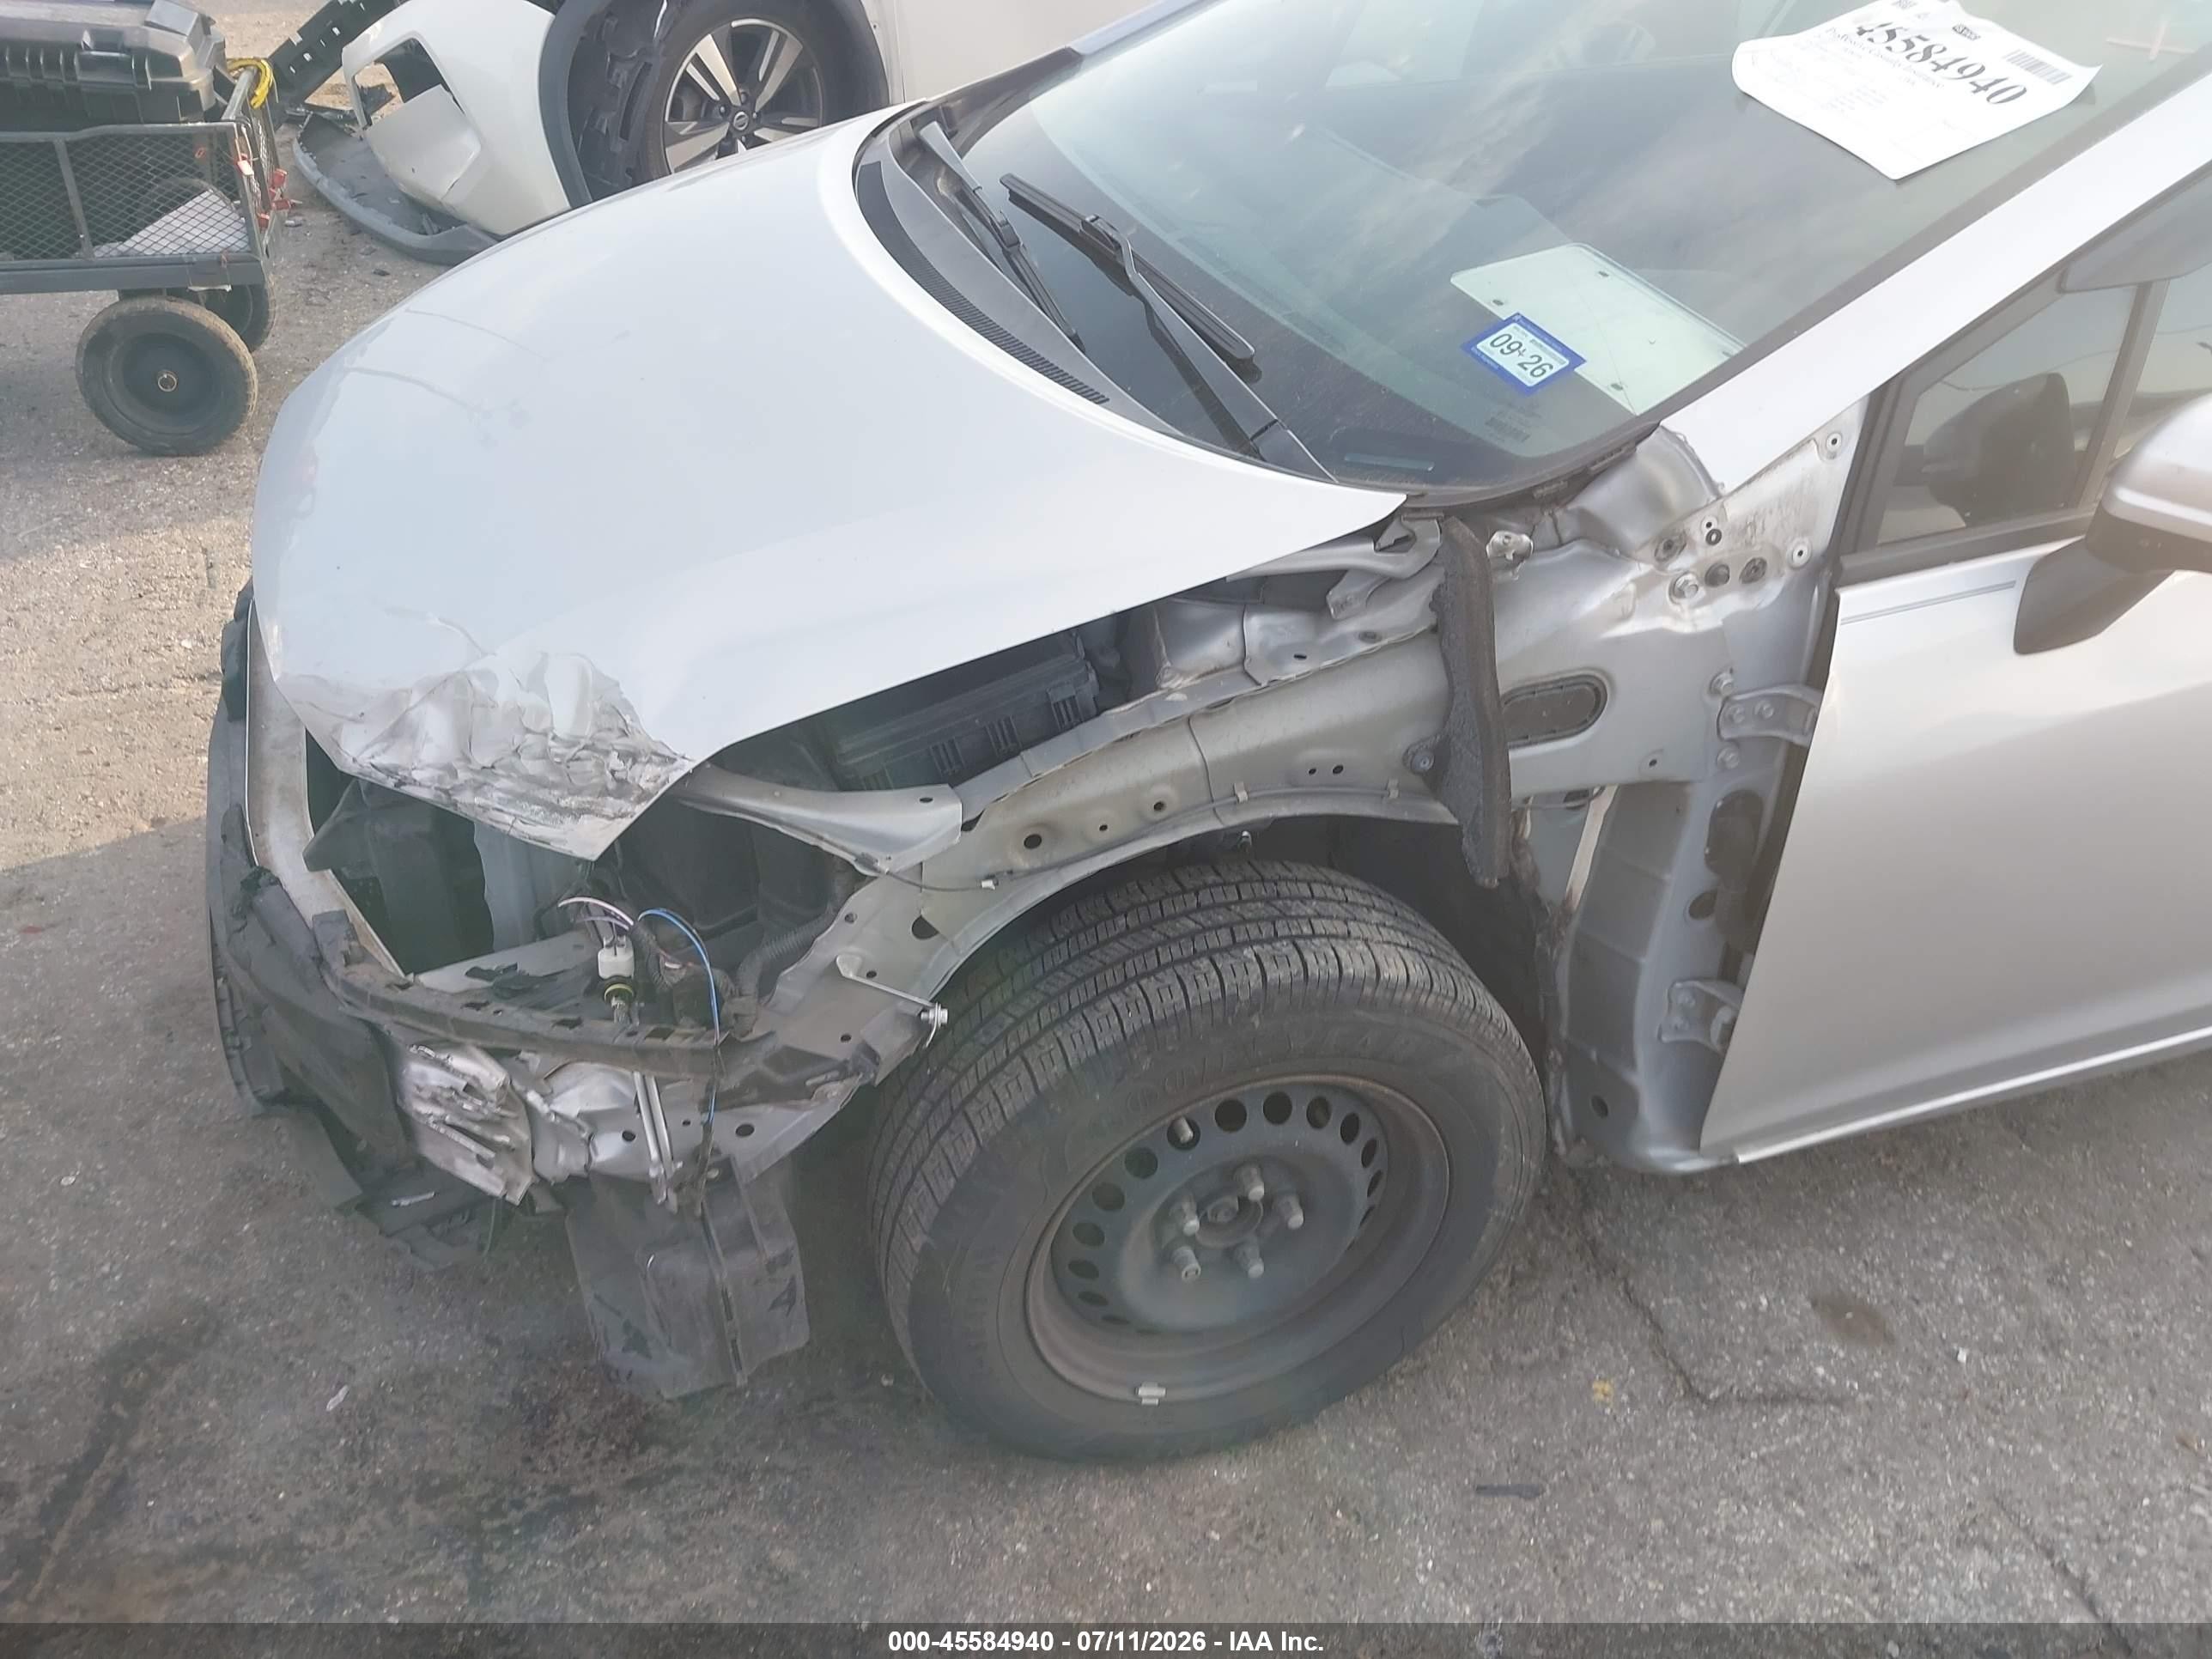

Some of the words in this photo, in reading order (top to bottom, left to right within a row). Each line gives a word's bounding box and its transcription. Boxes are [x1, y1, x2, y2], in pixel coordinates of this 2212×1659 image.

[1856, 21, 2028, 106] 45584940
[1489, 333, 1523, 356] 09
[1516, 354, 1554, 379] 26
